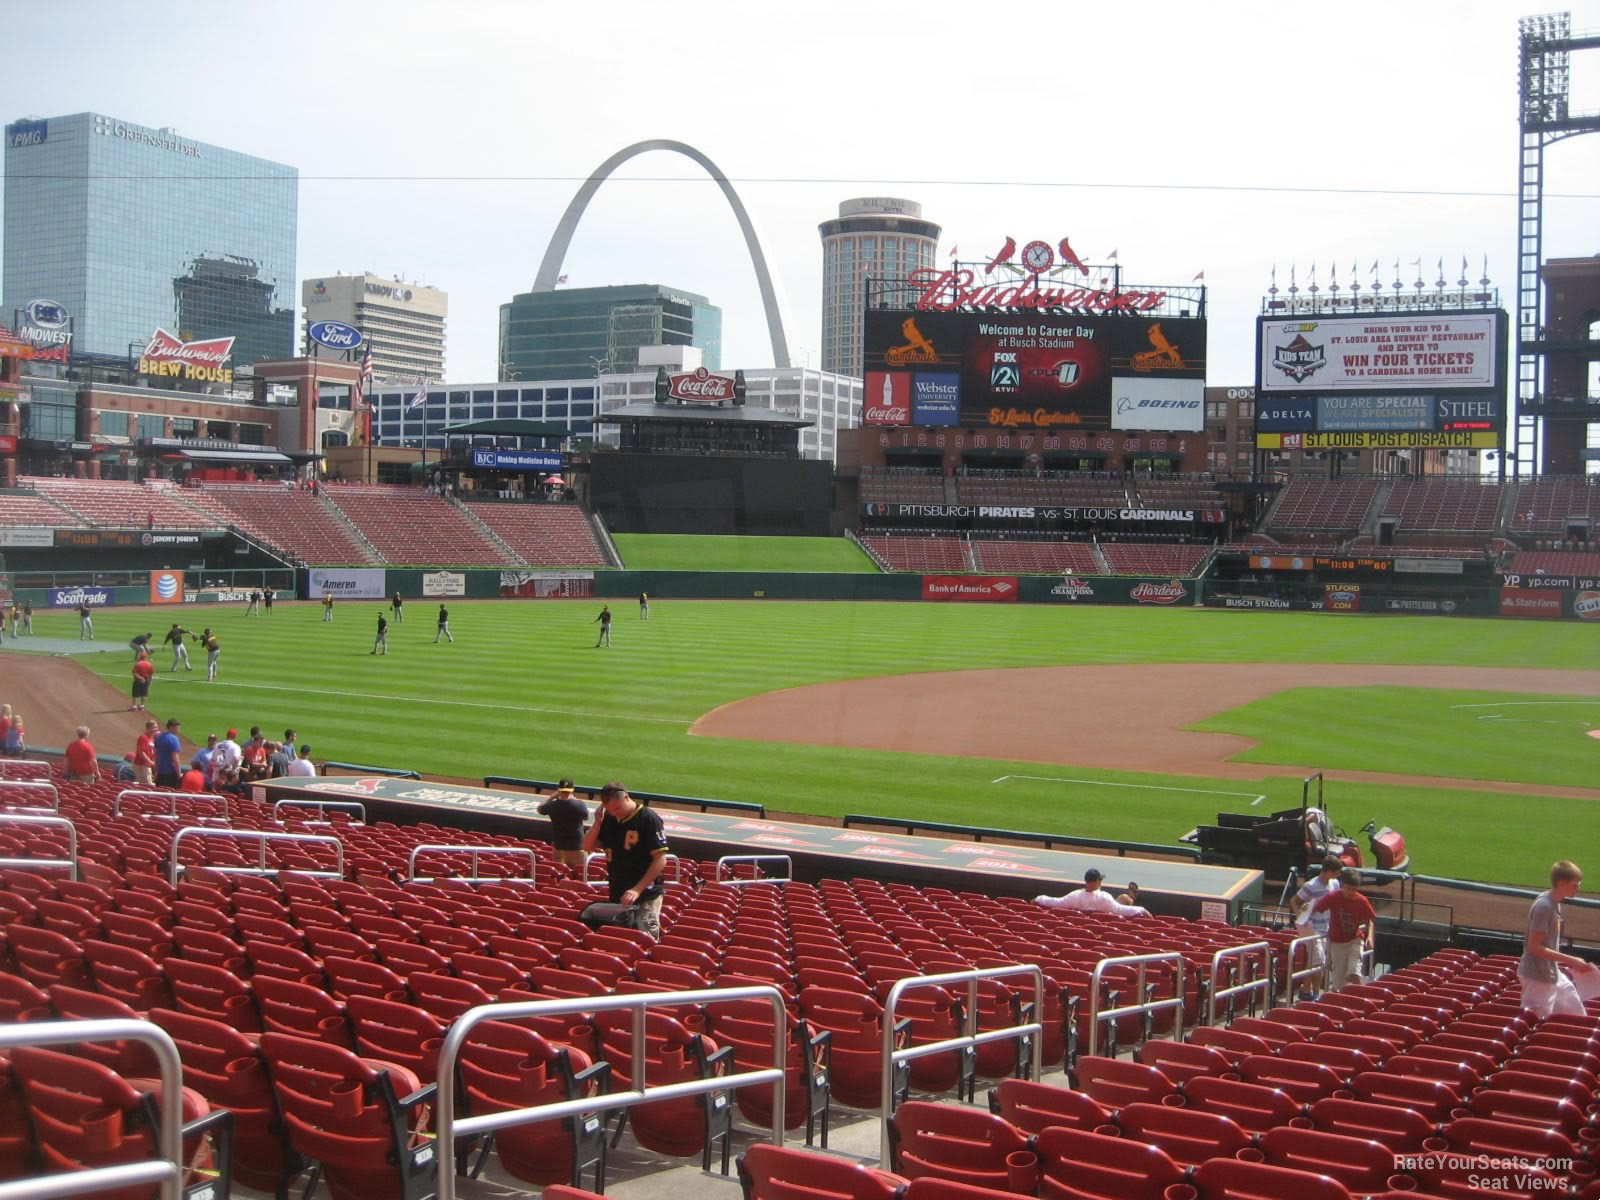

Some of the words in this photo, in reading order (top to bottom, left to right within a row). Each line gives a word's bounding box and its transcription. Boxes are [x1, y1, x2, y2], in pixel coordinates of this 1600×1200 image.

[9, 131, 41, 147] KPMG
[113, 124, 201, 158] GREENSFELDER
[365, 282, 392, 298] KMOV
[909, 268, 1166, 311] Budweiser
[1284, 297, 1354, 312] WORLD
[1357, 293, 1475, 308] CHAMPIONS
[35, 303, 60, 318] FOX
[321, 323, 353, 345] Ford
[979, 323, 1024, 335] Welcome
[1027, 325, 1037, 335] to
[1040, 325, 1073, 337] Career
[1076, 326, 1094, 339] Day
[1284, 322, 1318, 333] SUBWAY
[1364, 326, 1389, 334] BRING
[1391, 325, 1412, 333] YOUR
[1414, 325, 1429, 333] KID
[1444, 324, 1450, 332] A
[21, 326, 73, 345] MIDWEST
[1345, 336, 1368, 344] LOUIS
[1370, 335, 1392, 343] AREA
[1432, 333, 1485, 341] RESTAURANT
[998, 338, 1007, 347] at
[1010, 337, 1036, 347] Busch
[1039, 338, 1074, 348] Stadium
[1377, 344, 1395, 352] AND
[1397, 343, 1425, 351] ENTER
[1427, 343, 1439, 351] TO
[143, 337, 231, 363] Budweiser
[1279, 350, 1297, 362] KIDS
[1298, 349, 1320, 361] TEAM
[994, 352, 1017, 363] FOX
[1343, 354, 1369, 367] WIN
[1374, 353, 1406, 366] FOUR
[1414, 352, 1474, 365] TICKETS
[138, 359, 183, 377] BREW
[185, 365, 233, 384] HOUSE
[1000, 366, 1012, 385] 2
[1059, 363, 1078, 383] 11
[1345, 369, 1357, 377] TO
[1368, 368, 1415, 376] CARDINALS
[1418, 367, 1442, 375] HOME
[1445, 367, 1473, 375] GAME!
[677, 377, 726, 396] Coca-Cola
[916, 382, 957, 393] Webster
[1137, 400, 1200, 408] BOEING
[1324, 399, 1347, 409] YOU
[1351, 398, 1373, 409] ARE
[1376, 397, 1427, 408] SPECIAL
[1438, 400, 1497, 418] STIFEL
[866, 406, 908, 421] Coca-Cola
[1272, 410, 1312, 419] DELTA
[1324, 409, 1339, 418] WE
[1360, 408, 1427, 418] SPECIALISTS
[1358, 420, 1389, 429] University
[917, 434, 927, 446] 2
[936, 434, 945, 446] 6
[954, 434, 964, 447] 9
[974, 435, 987, 447] 10
[996, 435, 1010, 448] 14
[1020, 435, 1034, 448] 17
[1043, 436, 1061, 449] 20
[1070, 436, 1087, 449] 24
[1096, 437, 1114, 450] 42
[1123, 438, 1141, 451] 45
[1306, 434, 1324, 446] ST.
[1327, 433, 1364, 446] LOUIS
[1368, 432, 1473, 446] POST-DISPATCH
[476, 452, 494, 465] BJC
[497, 455, 517, 465] Making
[518, 456, 543, 465] Medicine
[544, 457, 560, 465] Better
[899, 504, 976, 517] PITTSBURGH
[979, 506, 1035, 518] PIRATES
[1064, 508, 1080, 519] ST.
[1083, 509, 1117, 520] LOUIS
[1120, 509, 1194, 521] CARDINALS
[152, 535, 175, 543] JIMMY
[176, 535, 199, 543] JOHN'S
[323, 579, 356, 588] Ameren
[1503, 575, 1520, 586] yp
[1528, 578, 1569, 587] yp.com
[1579, 579, 1593, 588] yp
[929, 584, 949, 592] Bank
[958, 585, 991, 593] America
[56, 588, 107, 605] Scottrade
[218, 592, 244, 601] BUSCH
[1515, 598, 1536, 606] State
[1537, 599, 1559, 608] Farm
[1226, 599, 1252, 607] BUSCH
[1254, 600, 1290, 608] STADIUM
[1401, 600, 1438, 610] POSTSEASON
[624, 831, 639, 850] P
[977, 860, 1018, 870] 2013
